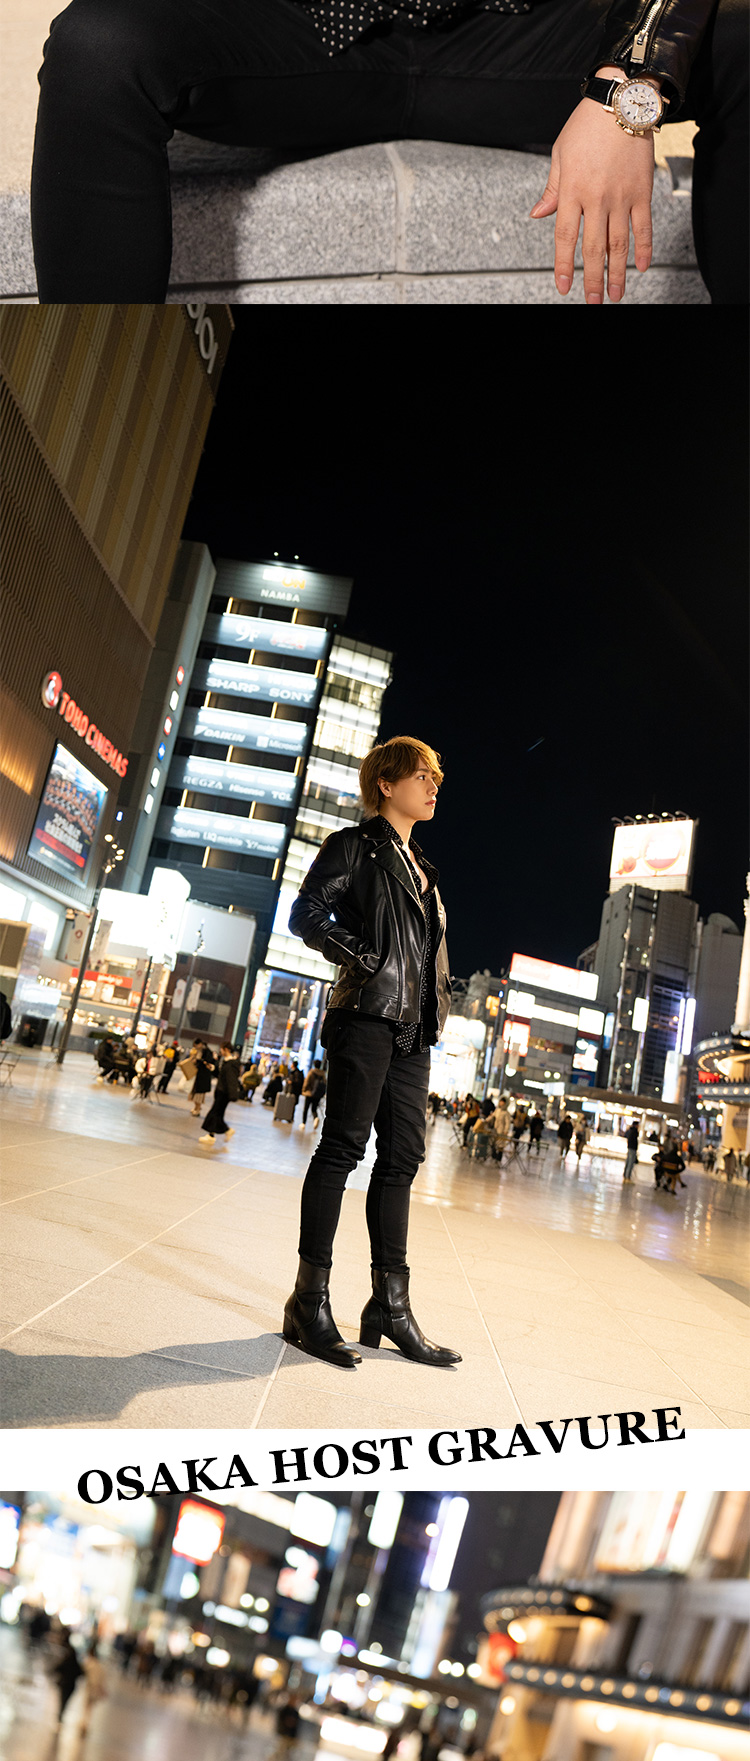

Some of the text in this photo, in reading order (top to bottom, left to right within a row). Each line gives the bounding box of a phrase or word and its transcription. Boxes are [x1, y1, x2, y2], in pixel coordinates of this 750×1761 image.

[260, 589, 300, 602] NAMBA
[235, 622, 261, 642] 9F
[206, 678, 314, 702] SHARP SONY
[58, 691, 129, 777] TOHO CINEMAS
[204, 729, 246, 742] DAIKIN
[183, 776, 223, 790] REGZA
[271, 790, 293, 802] TCL
